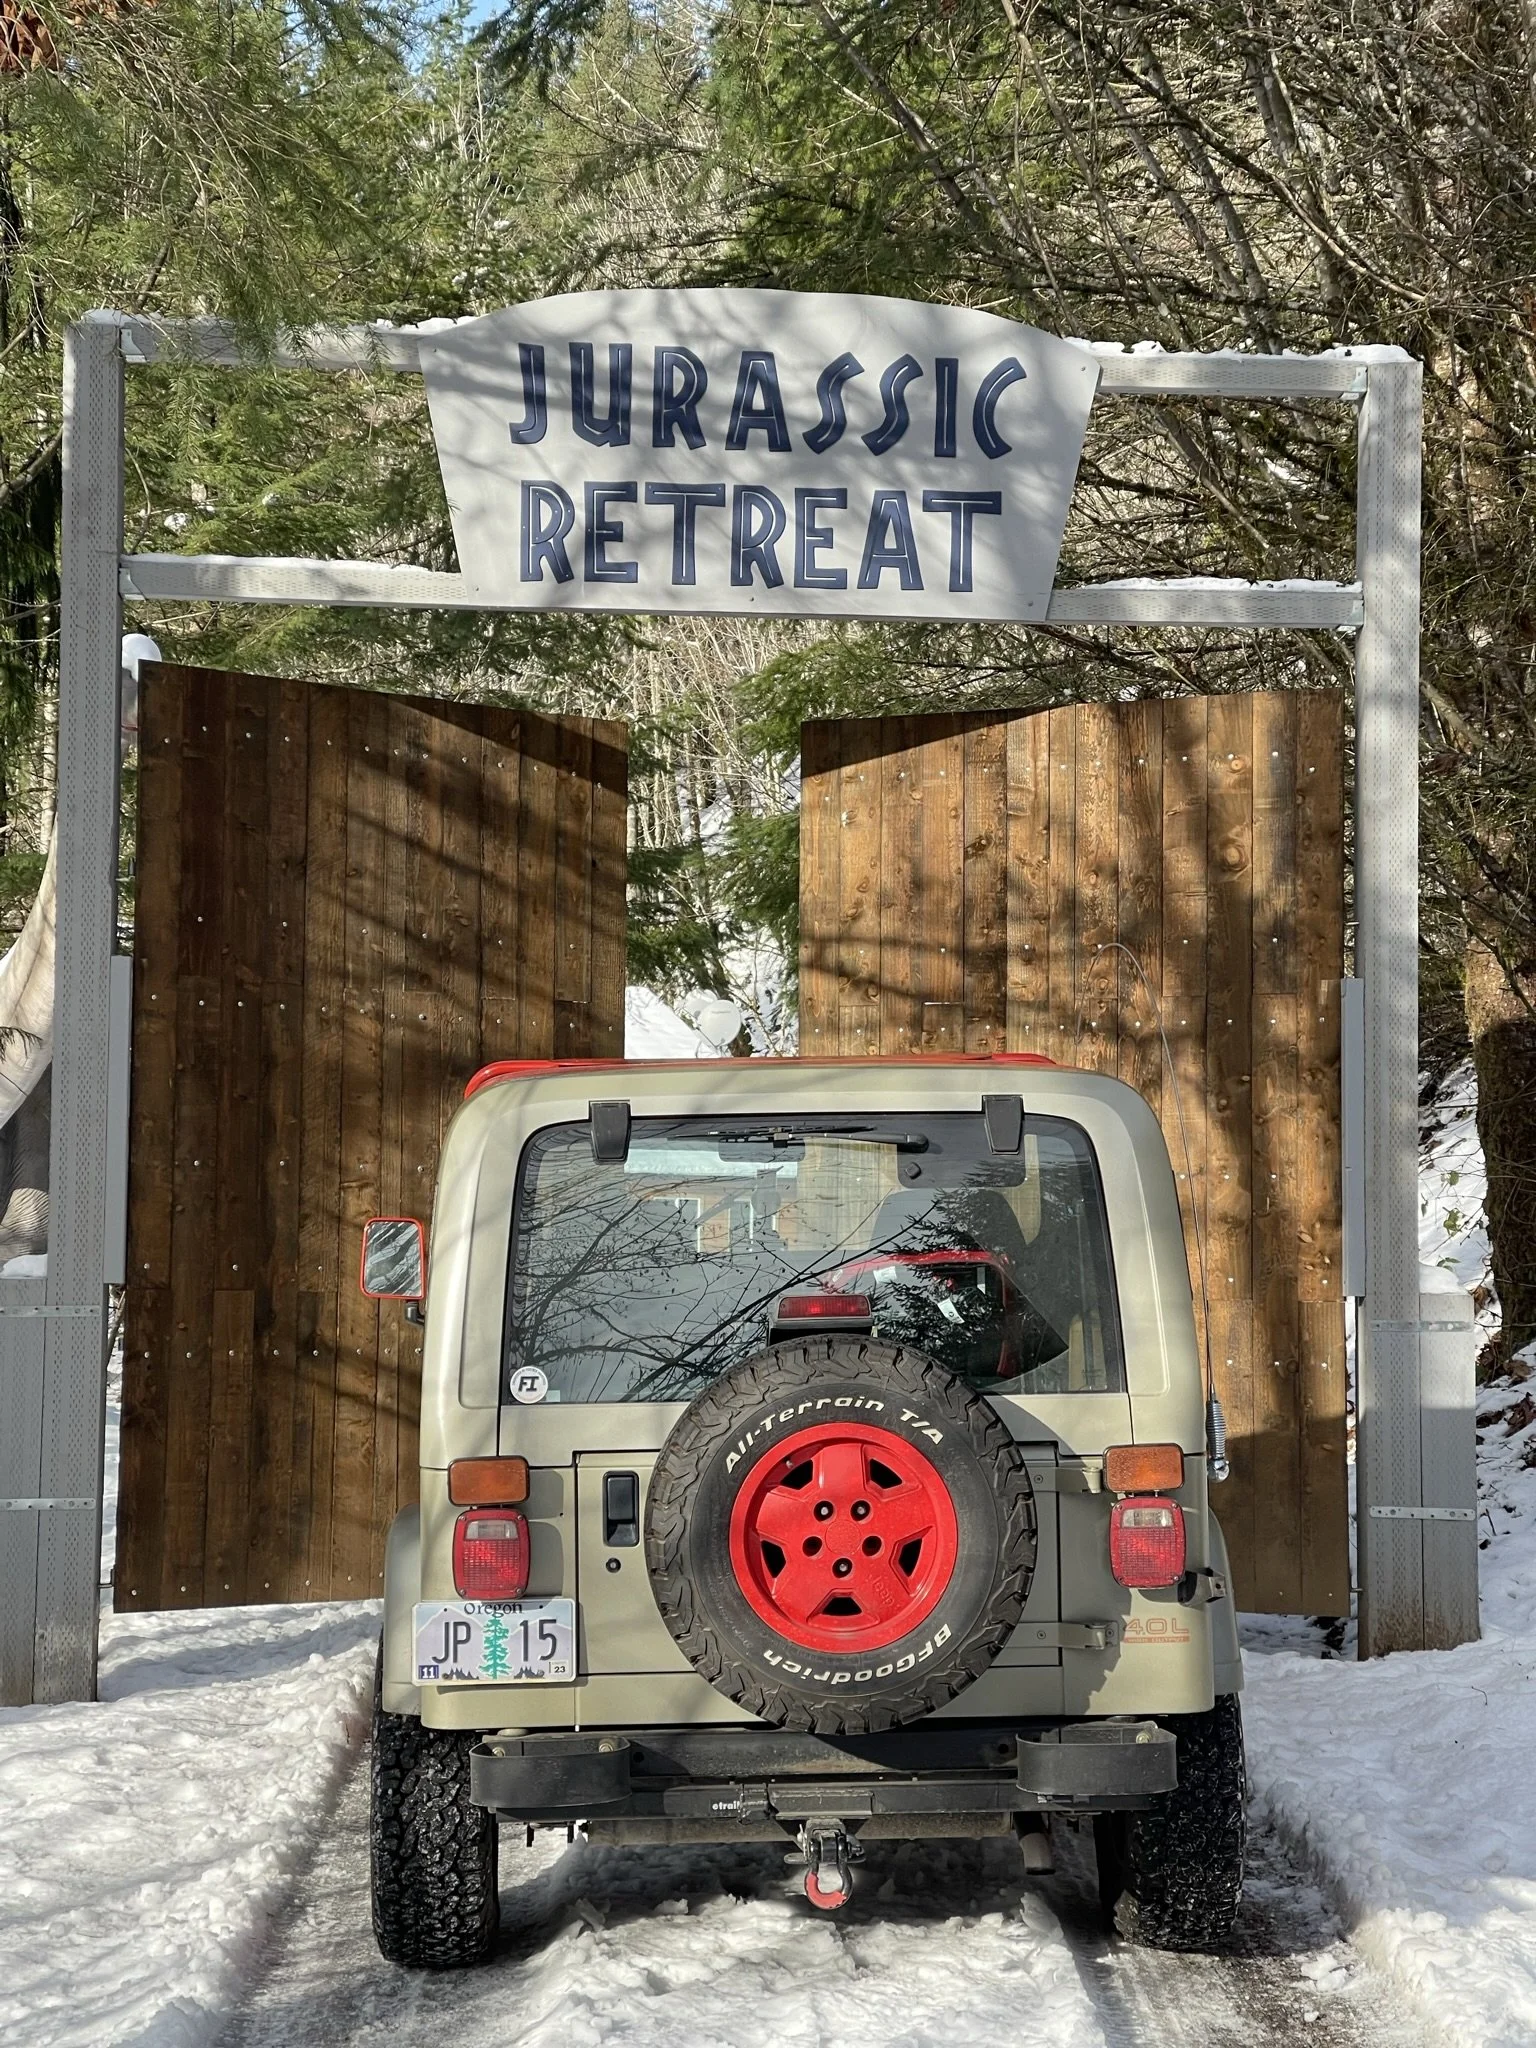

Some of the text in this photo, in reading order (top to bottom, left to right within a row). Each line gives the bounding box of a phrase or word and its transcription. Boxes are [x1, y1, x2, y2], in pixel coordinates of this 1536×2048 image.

[509, 342, 1028, 460] JURASSIC
[520, 480, 1002, 594] RETREAT
[726, 1396, 945, 1474] All-Terrain T/A
[464, 1602, 523, 1618] Oregon
[431, 1618, 557, 1664] JP 15
[763, 1623, 951, 1685] BFGoodrich
[421, 1666, 436, 1679] 11
[554, 1666, 566, 1674] 23
